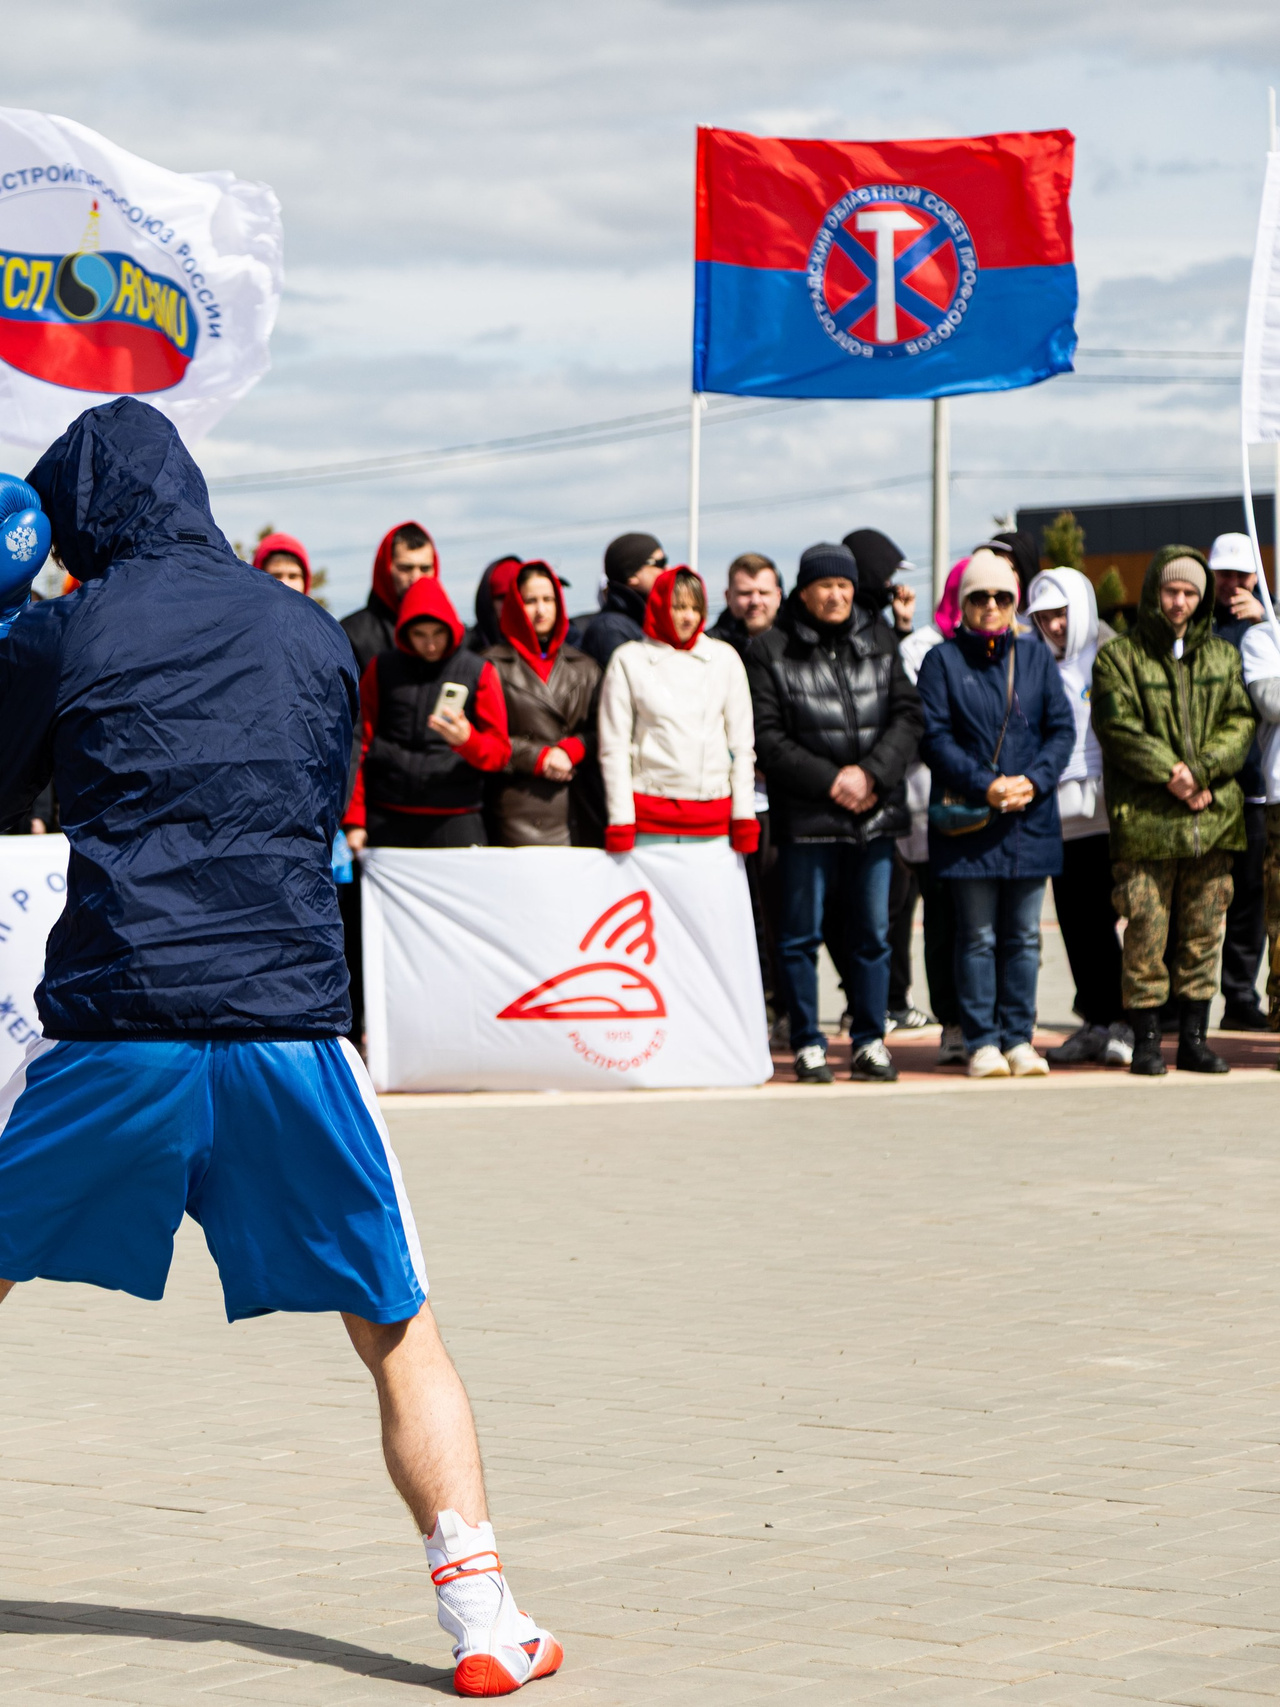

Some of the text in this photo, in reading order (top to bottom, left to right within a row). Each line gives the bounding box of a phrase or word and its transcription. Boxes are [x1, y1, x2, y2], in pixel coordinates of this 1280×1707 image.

[826, 184, 921, 230] ОБЛАСТНОЙ
[923, 193, 970, 243] СОВЕТ
[176, 243, 222, 339] РОССИИ
[905, 246, 977, 356] ПРОФСОЮЗОВ
